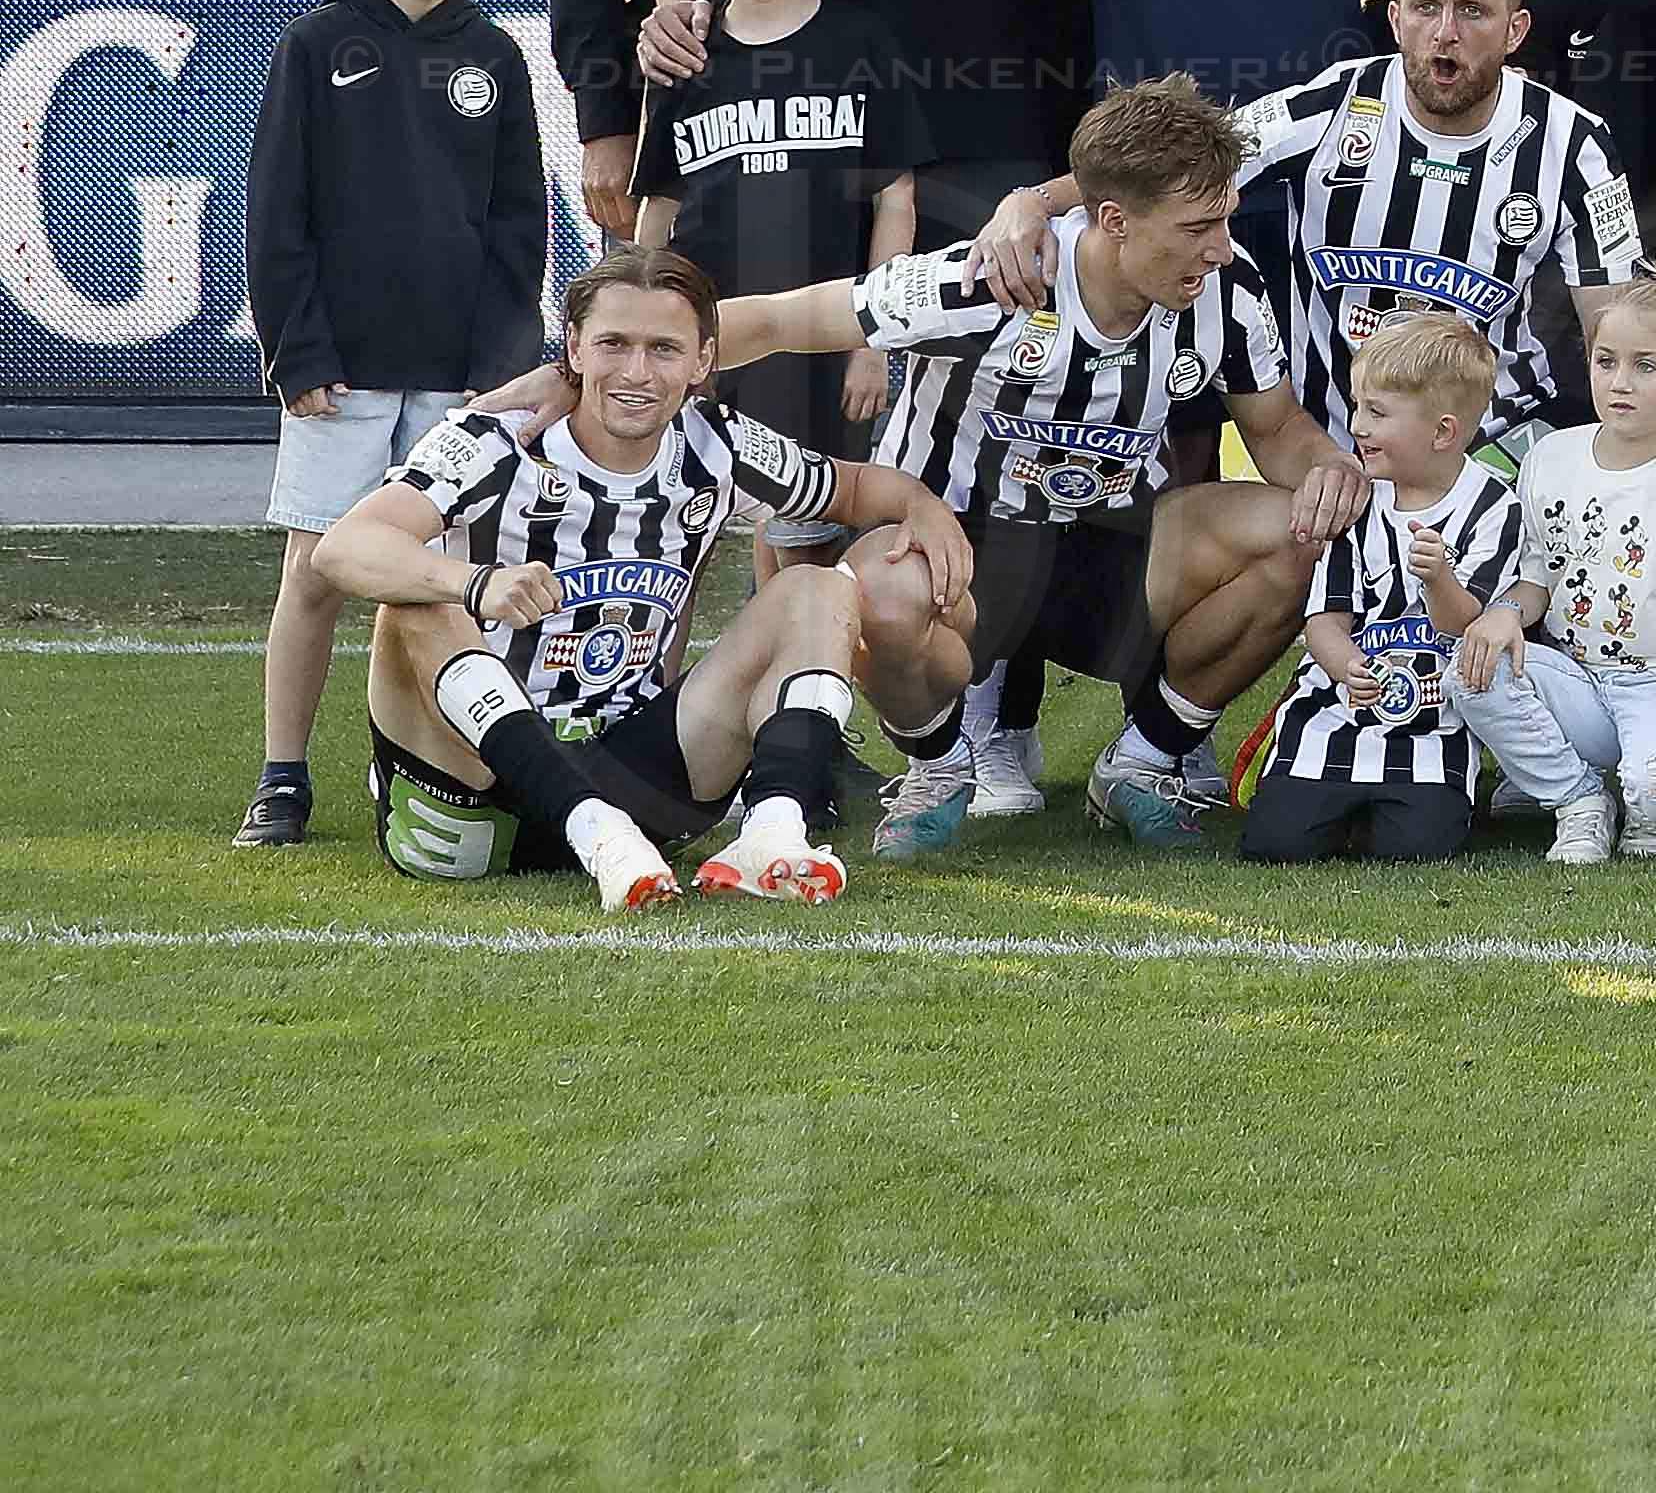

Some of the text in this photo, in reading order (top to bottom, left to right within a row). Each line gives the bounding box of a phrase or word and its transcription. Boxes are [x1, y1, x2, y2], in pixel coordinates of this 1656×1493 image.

[675, 96, 777, 166] STURM
[742, 150, 789, 176] 1909
[1425, 165, 1471, 186] GRAWE
[1328, 253, 1508, 317] PUNTIGAMER
[1099, 353, 1138, 370] GRAWE
[469, 689, 506, 722] 25
